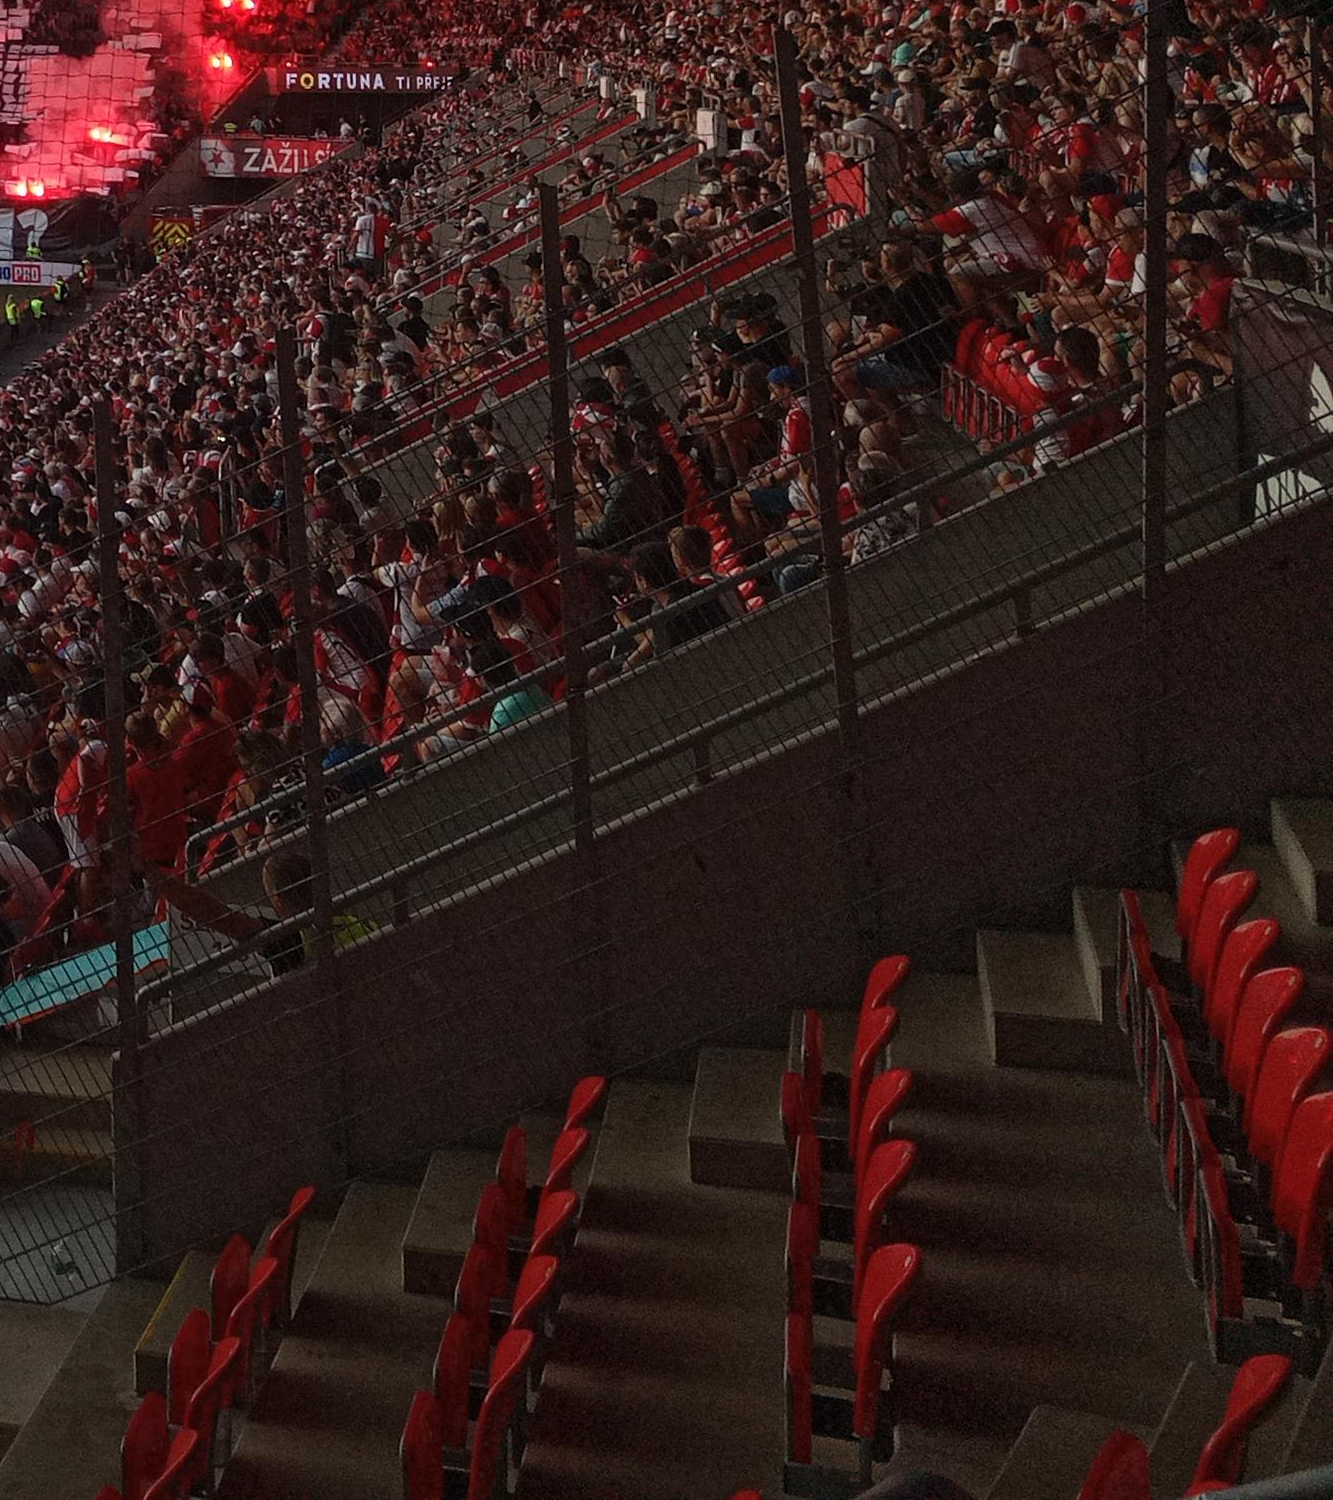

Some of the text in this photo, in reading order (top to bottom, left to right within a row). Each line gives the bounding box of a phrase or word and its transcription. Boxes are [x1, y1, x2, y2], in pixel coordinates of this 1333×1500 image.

[286, 73, 385, 89] FORTUNA
[395, 76, 411, 90] TI
[14, 266, 40, 280] PRO
